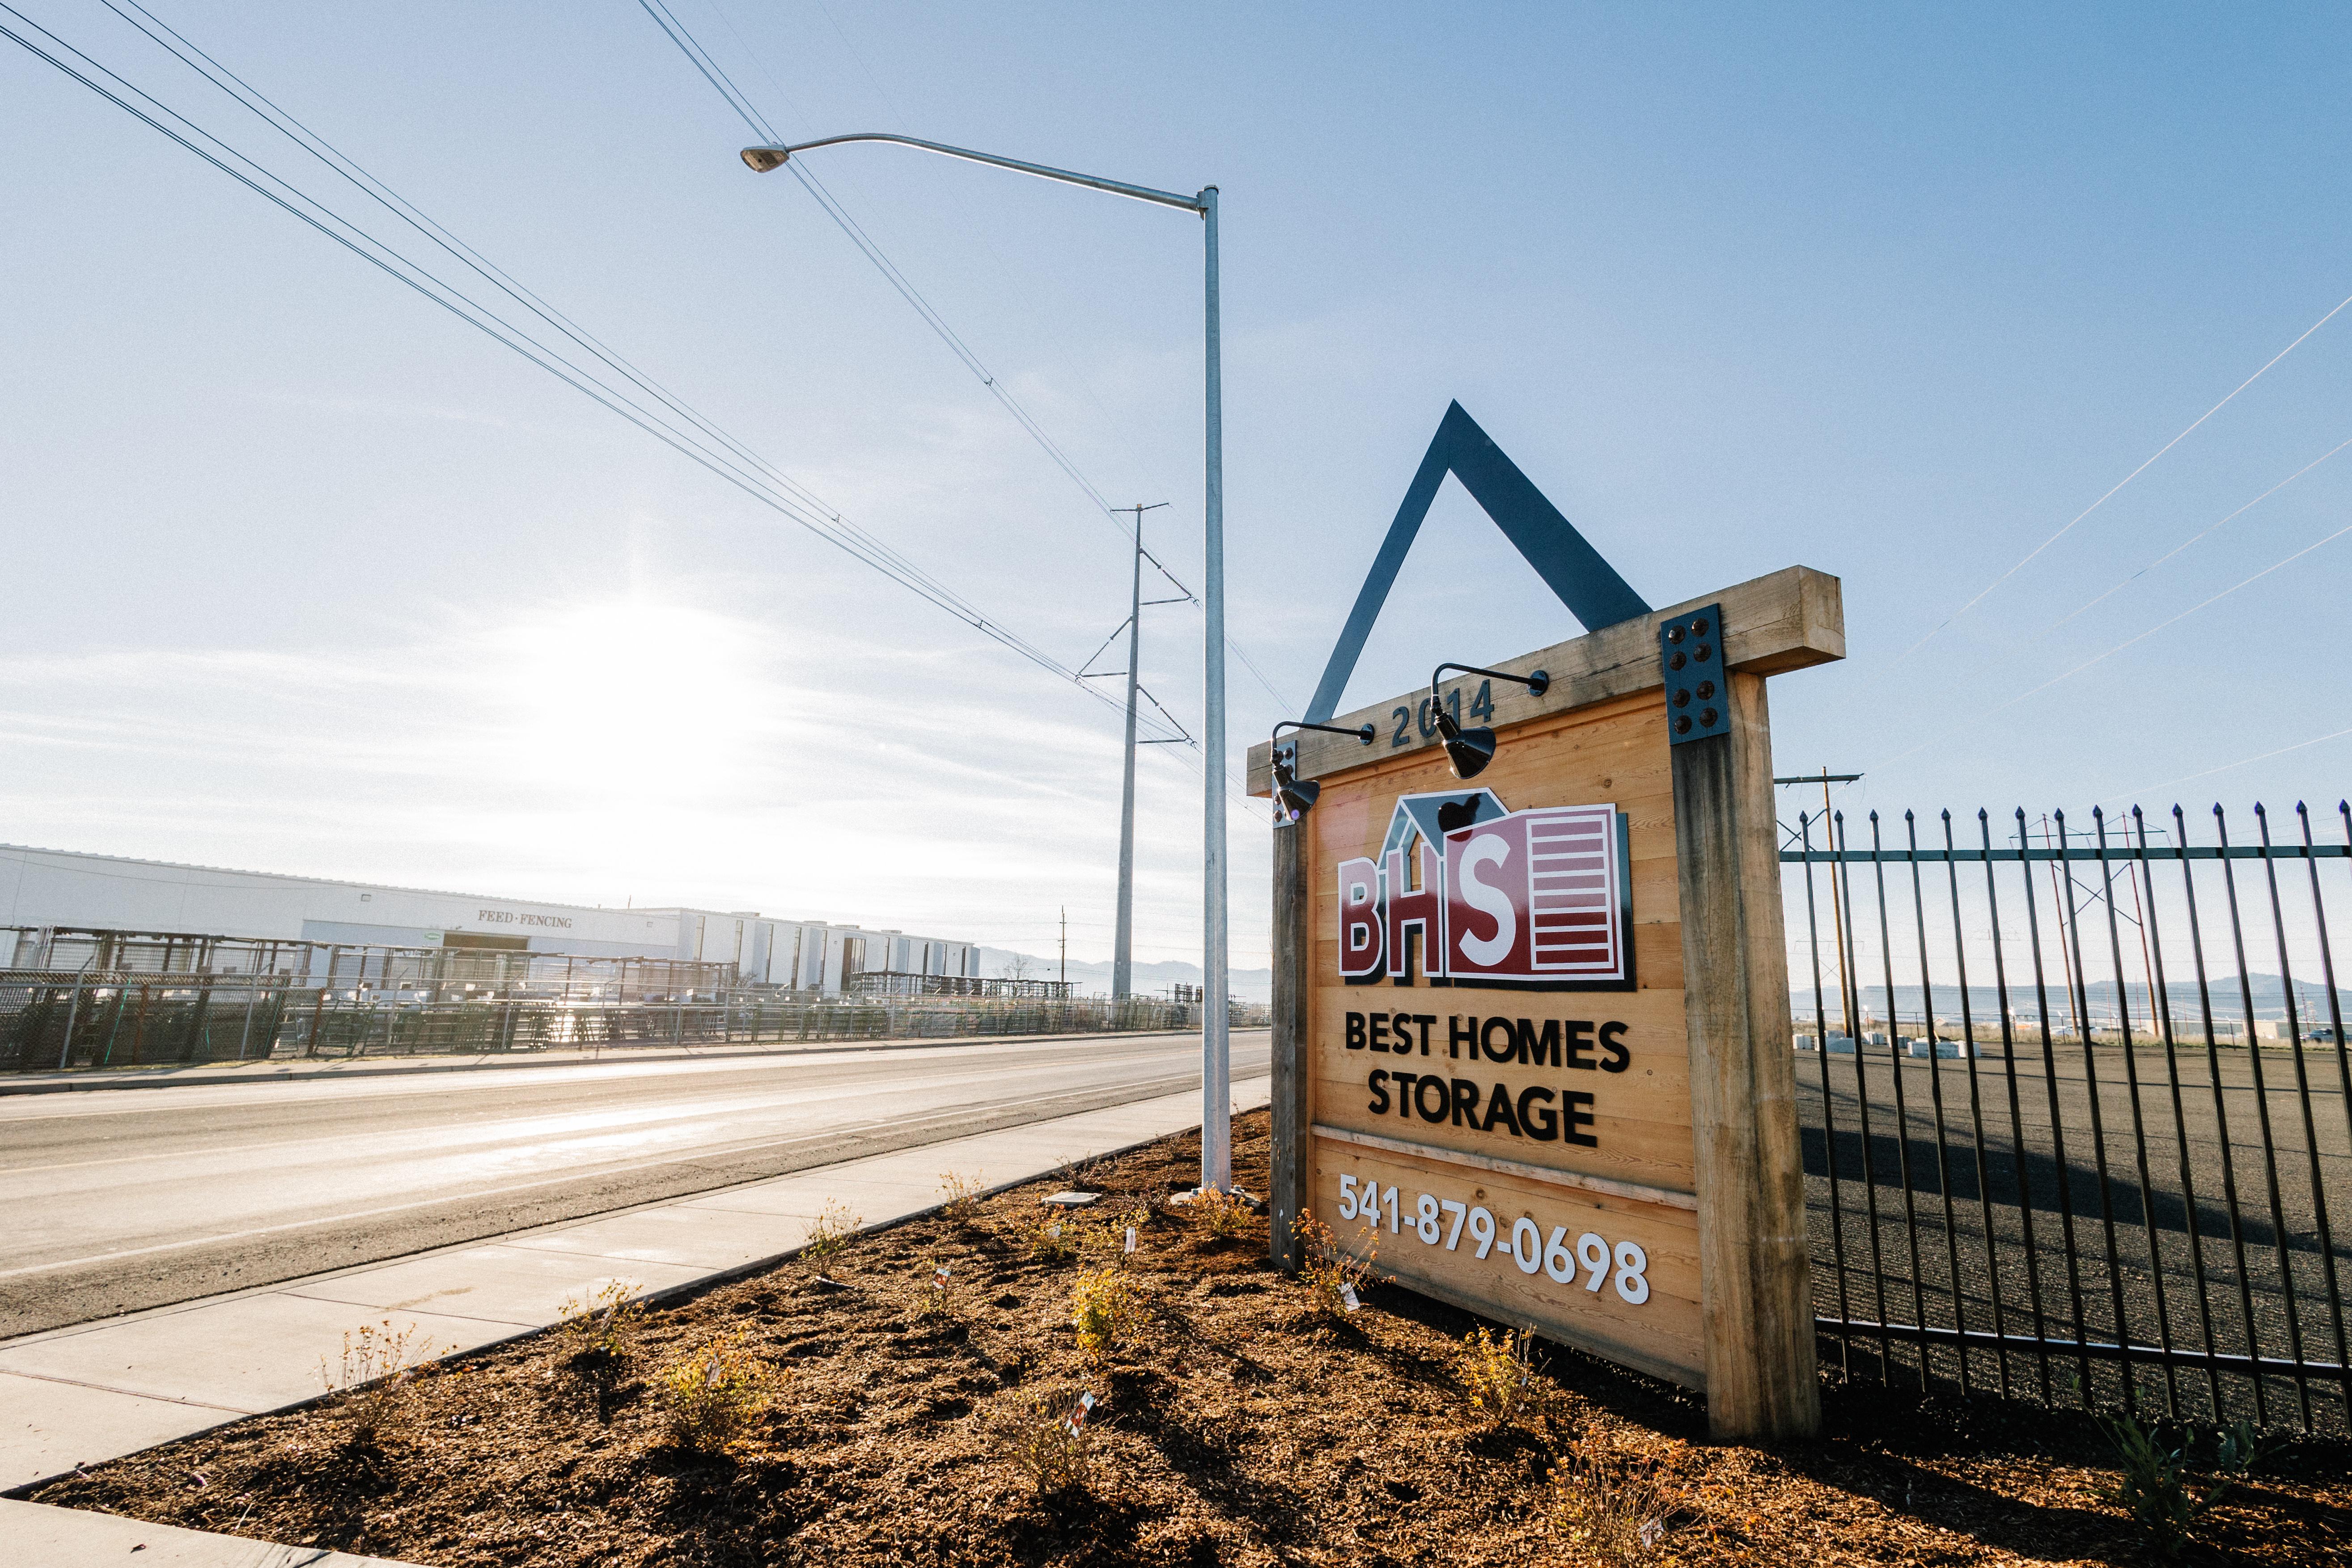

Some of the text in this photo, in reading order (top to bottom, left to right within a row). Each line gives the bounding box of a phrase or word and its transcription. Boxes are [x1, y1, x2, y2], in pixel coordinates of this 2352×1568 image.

[1392, 678, 1494, 747] 2014
[478, 910, 572, 928] FEED FENCING
[1338, 833, 1517, 977] BHS
[1345, 1012, 1631, 1073] BEST HOMES
[1368, 1069, 1598, 1148] STORAGE
[1339, 1174, 1649, 1305] 541-879-0698
